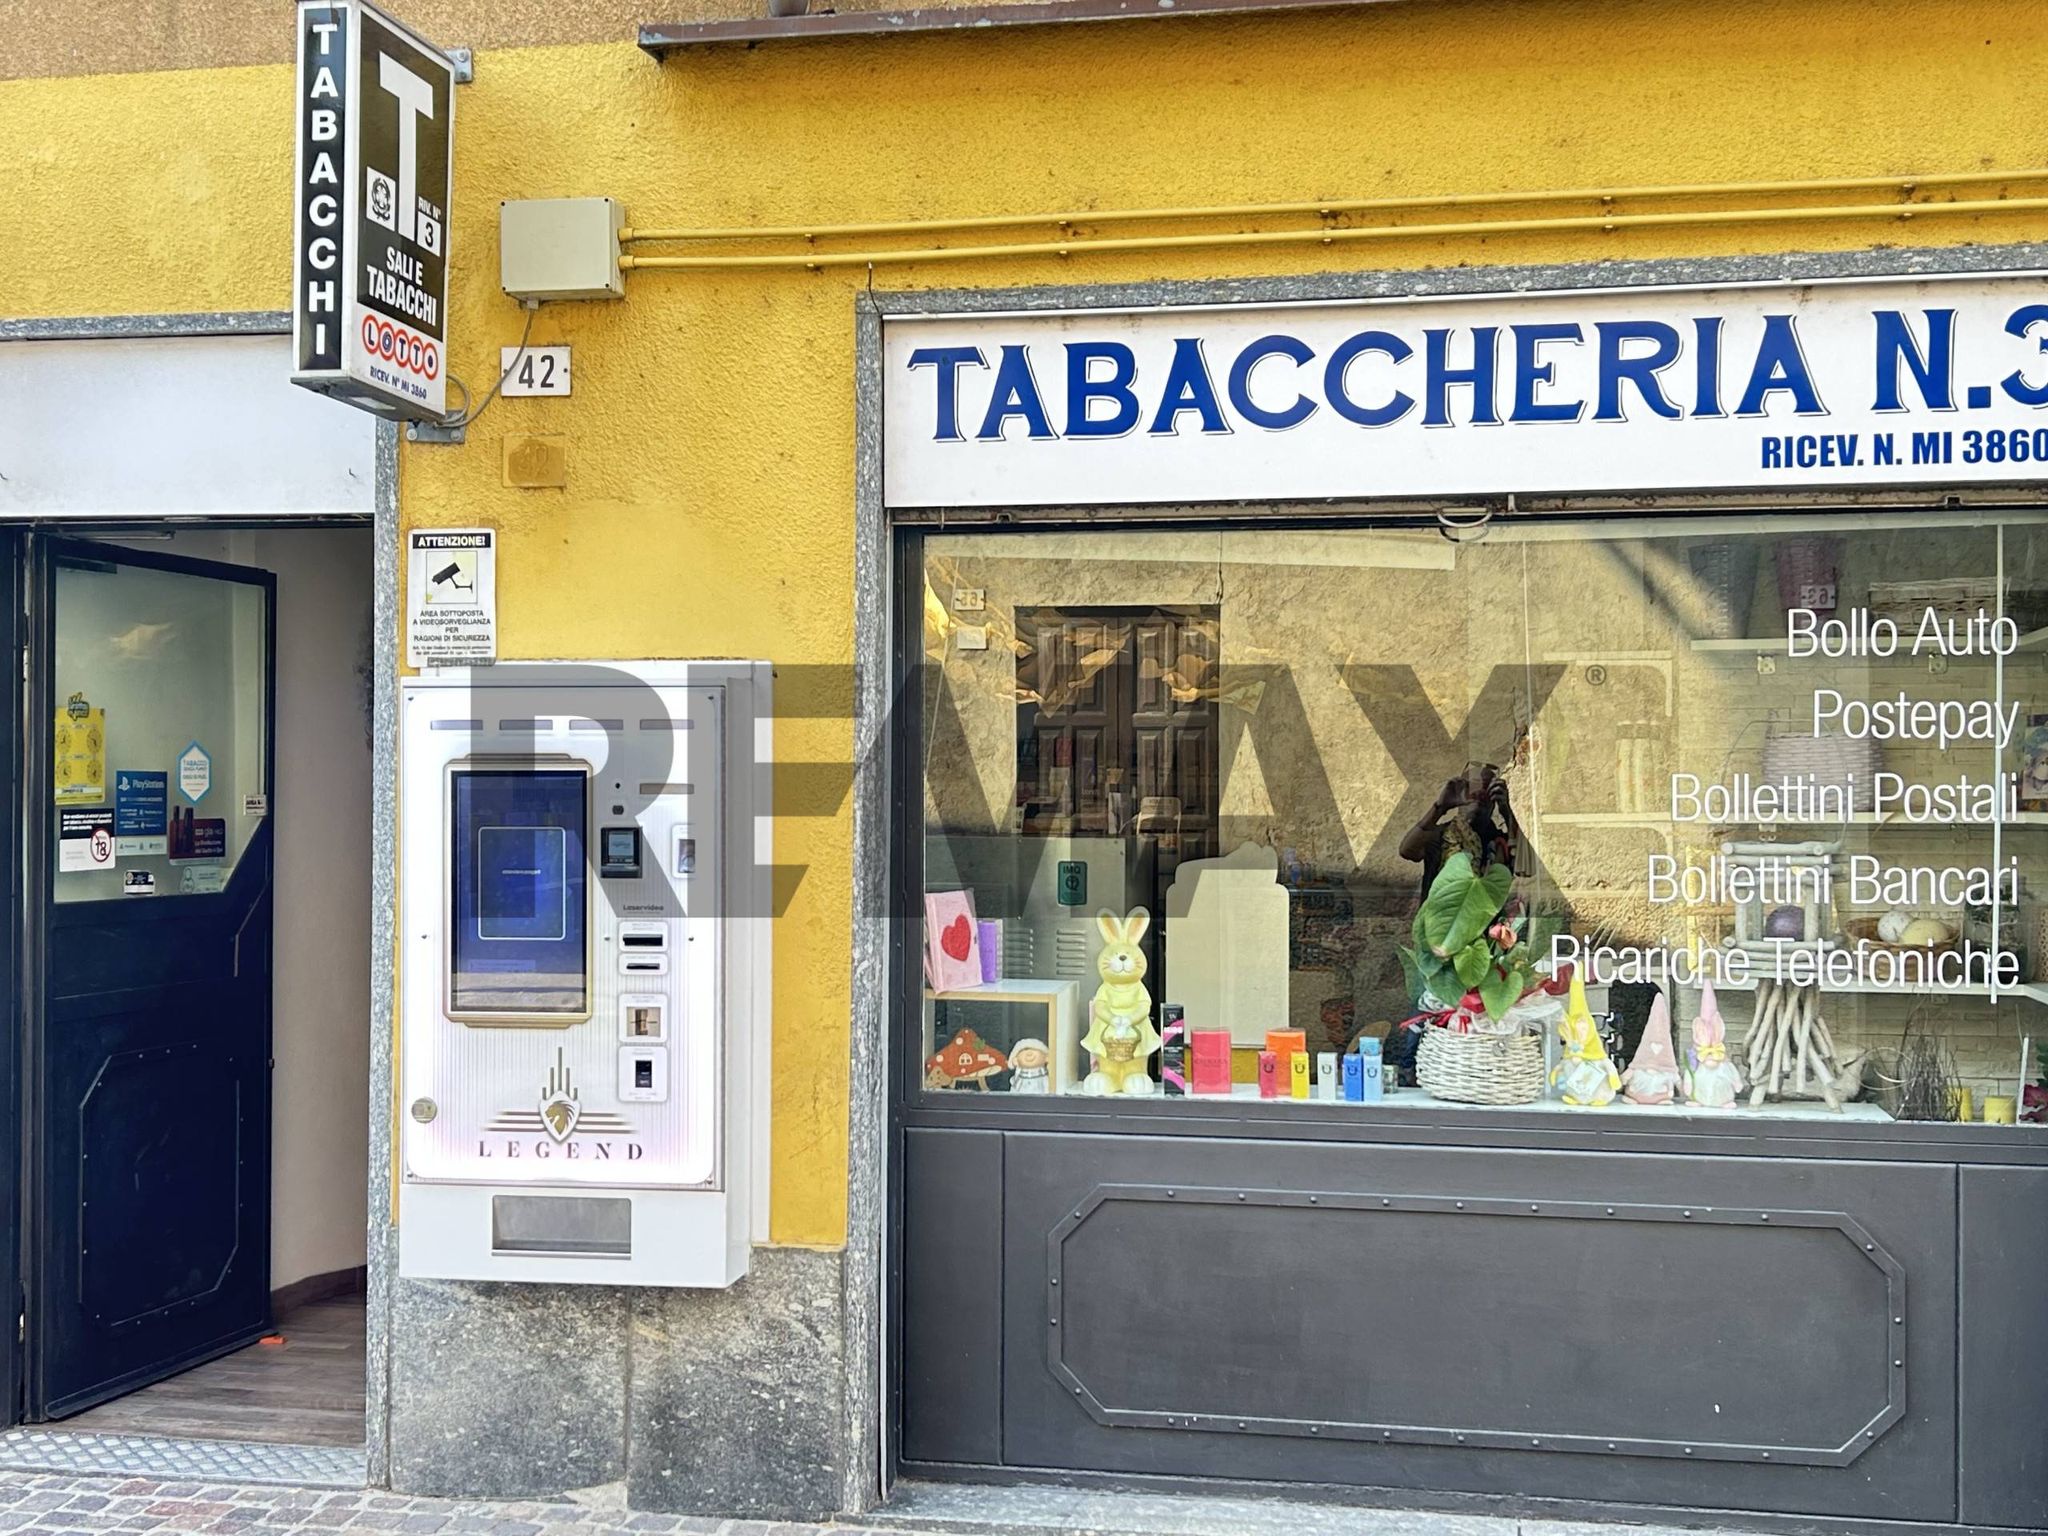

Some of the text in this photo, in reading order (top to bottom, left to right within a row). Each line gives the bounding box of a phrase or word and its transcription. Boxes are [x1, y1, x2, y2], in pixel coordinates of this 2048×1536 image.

[379, 50, 434, 241] T
[308, 24, 339, 355] TABACCHI
[425, 221, 434, 248] 3
[386, 246, 424, 286] SALI E
[366, 264, 437, 327] TABACCHI
[363, 316, 437, 379] LOTTO
[518, 354, 555, 389] 42
[370, 365, 391, 385] RICEV.
[906, 313, 1832, 443] TABACCHERIA
[1761, 428, 2048, 469] RICEV. N. MI 3860
[418, 535, 486, 547] ATTENZIONE!
[419, 618, 491, 626] VIDEOSORVEGLIANZA
[1787, 606, 2019, 657] Bollo Auto
[1812, 689, 2020, 749] Postepay
[1670, 771, 2018, 822] Bollettini Postali
[95, 841, 107, 857] 18
[1647, 853, 2019, 906] Bollettini Bancari
[1549, 934, 2020, 989] Ricariche Telefoniche
[478, 1140, 644, 1161] LEGEND
